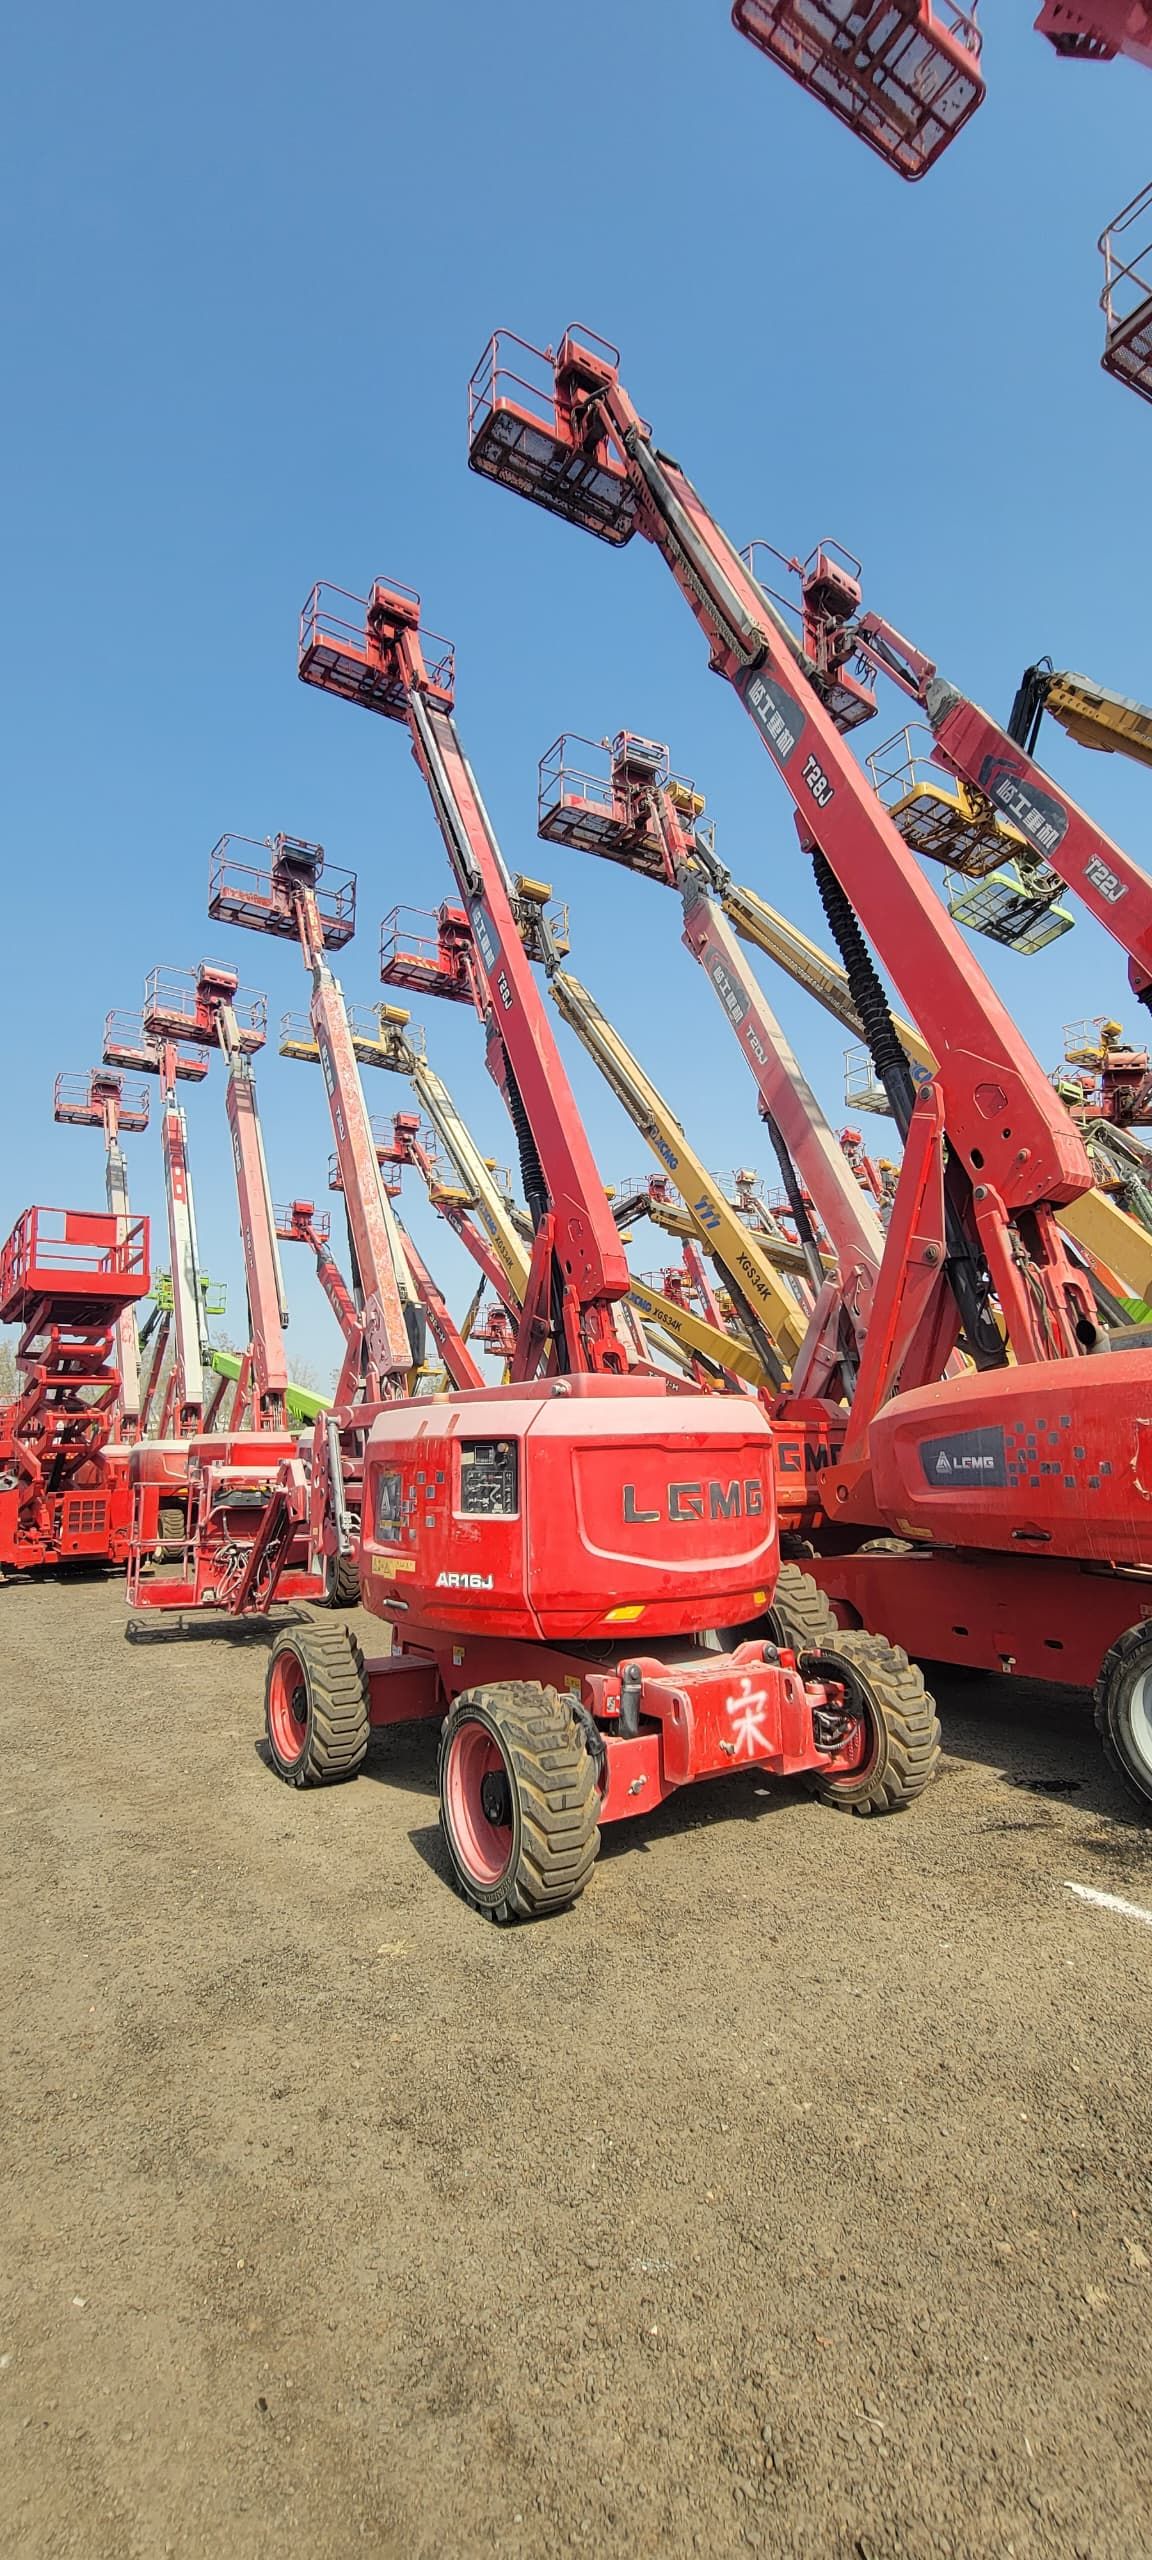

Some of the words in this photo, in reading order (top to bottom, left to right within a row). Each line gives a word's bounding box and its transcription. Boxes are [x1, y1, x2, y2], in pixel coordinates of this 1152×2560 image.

[748, 679, 795, 757] 临工重机
[802, 754, 835, 808] T28J
[996, 779, 1060, 848] 临工重机
[1084, 855, 1127, 902] T22J
[498, 971, 512, 1010] T28J
[746, 1025, 768, 1065] T20J
[655, 1136, 678, 1169] XCMG
[736, 1251, 772, 1301] XGS34K
[652, 1308, 682, 1332] XGS34K
[953, 1456, 994, 1469] LGMG
[623, 1479, 762, 1523] LGMG
[435, 1571, 494, 1590] AR16J
[726, 1677, 774, 1757] 宋
